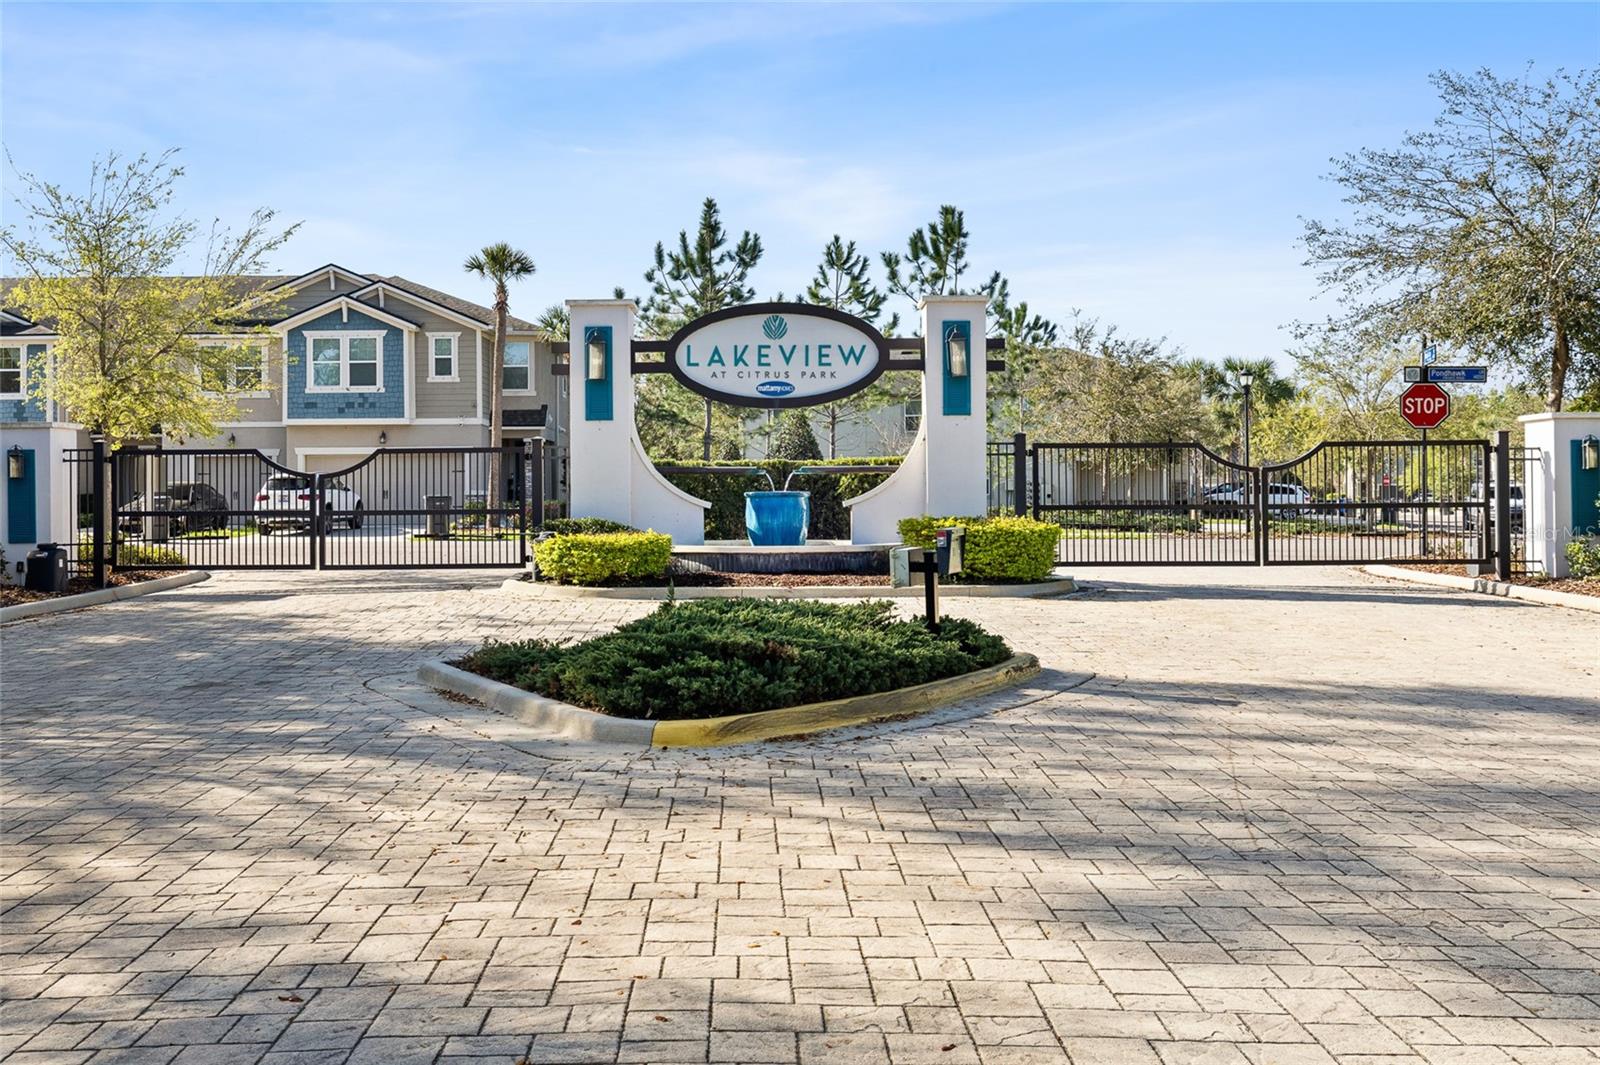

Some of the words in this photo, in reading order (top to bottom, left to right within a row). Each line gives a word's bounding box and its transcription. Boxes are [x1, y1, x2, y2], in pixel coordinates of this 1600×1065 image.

[686, 344, 867, 367] LAKEVIEW
[711, 371, 727, 379] AT
[737, 371, 790, 379] CITRUS
[801, 371, 837, 379] PARK
[1404, 397, 1446, 414] STOP
